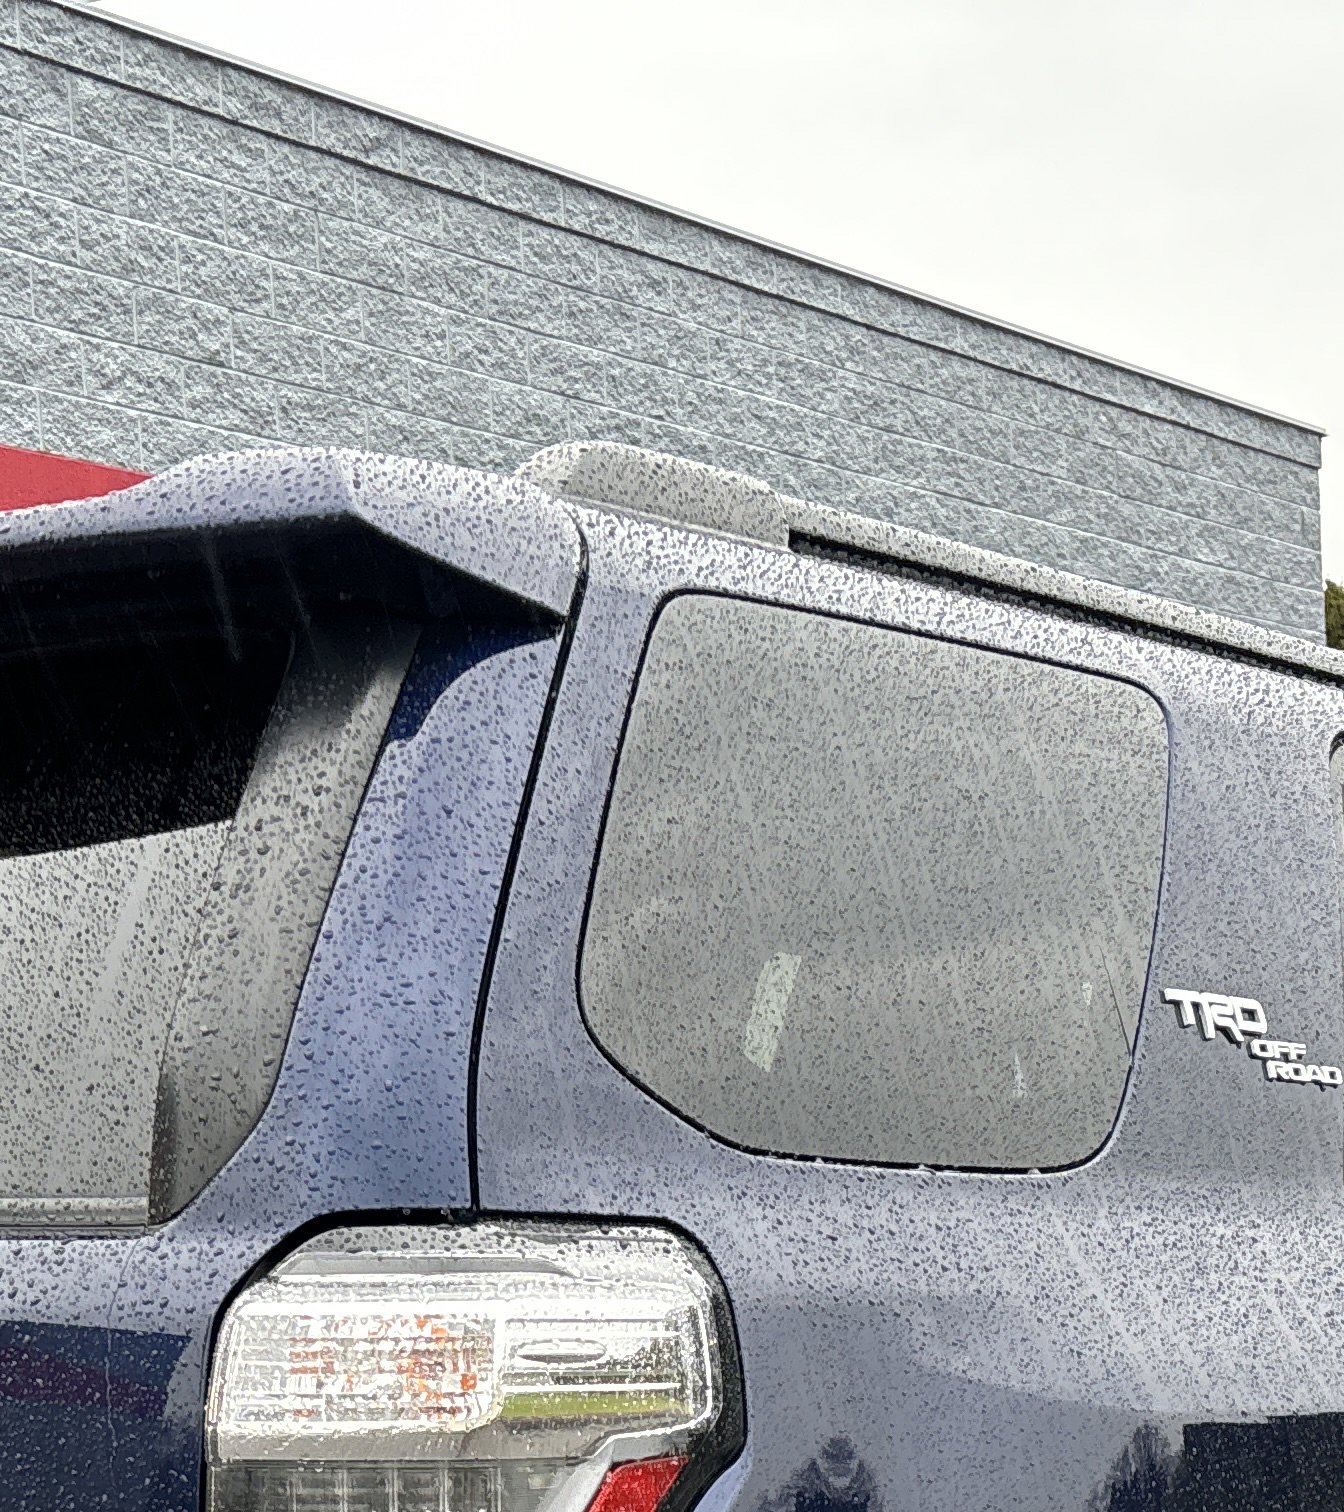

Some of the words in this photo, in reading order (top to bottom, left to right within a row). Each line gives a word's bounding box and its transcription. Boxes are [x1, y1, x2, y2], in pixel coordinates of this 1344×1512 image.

[1163, 987, 1268, 1044] TRD
[1249, 1038, 1307, 1061] OFF
[1264, 1059, 1343, 1086] ROAD
